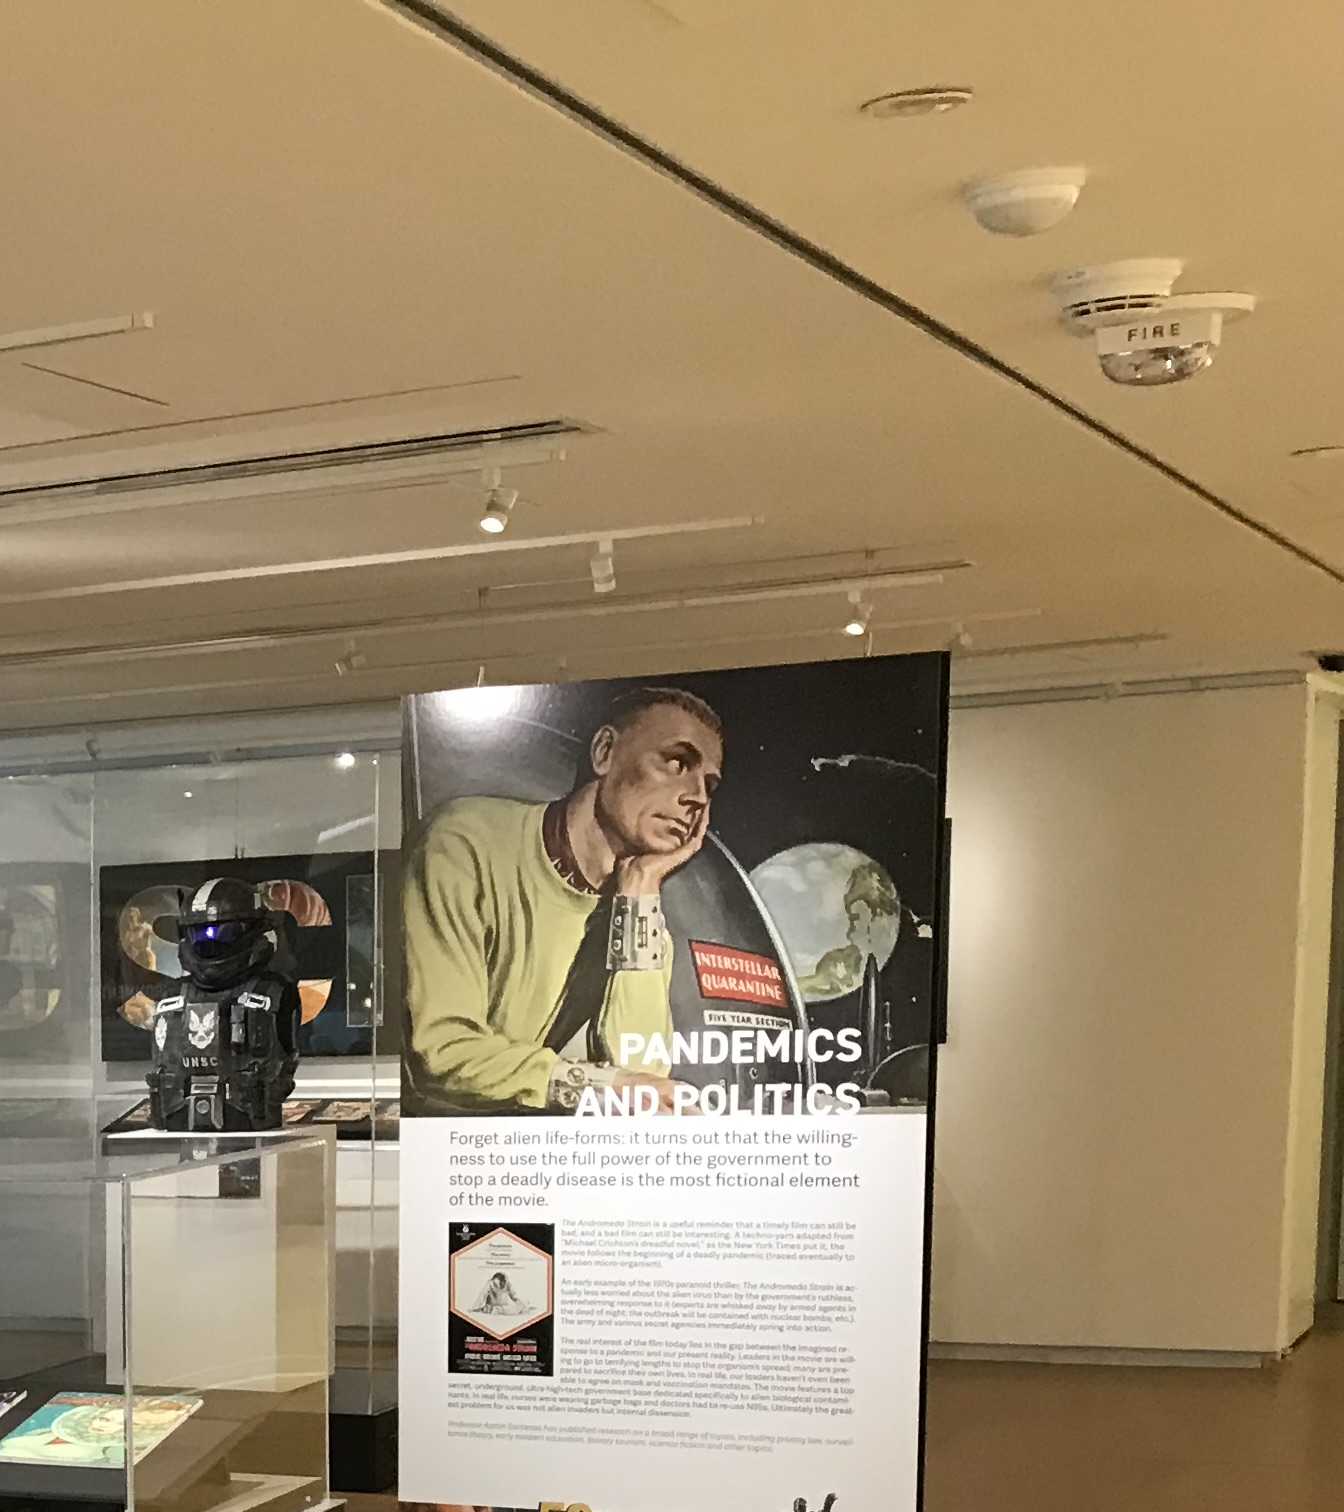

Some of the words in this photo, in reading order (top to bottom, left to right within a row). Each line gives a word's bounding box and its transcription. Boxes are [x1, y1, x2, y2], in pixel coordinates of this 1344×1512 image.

[1127, 322, 1181, 341] FIRE
[694, 951, 781, 981] INTERSTELLAR
[701, 973, 782, 1001] QUARANTINE
[708, 1013, 727, 1023] FIVE
[730, 1015, 753, 1026] YEAR
[619, 1028, 862, 1065] PANDEMICS
[182, 1056, 218, 1068] UNSC
[575, 1084, 661, 1117] AND
[673, 1083, 862, 1117] POLITICS
[449, 1131, 500, 1148] Forget
[503, 1130, 541, 1145] alien
[545, 1130, 625, 1145] life-forms:
[629, 1131, 640, 1145] it
[644, 1131, 688, 1145] turns
[692, 1131, 720, 1145] out
[724, 1130, 760, 1145] that
[763, 1129, 792, 1145] the
[796, 1129, 858, 1147] willing-
[449, 1154, 486, 1166] ness
[488, 1152, 506, 1166] to
[509, 1154, 537, 1166] use
[541, 1151, 568, 1166] the
[571, 1150, 596, 1166] full
[600, 1154, 651, 1169] power
[655, 1150, 672, 1166] of
[675, 1151, 703, 1166] the
[706, 1152, 810, 1170] government
[814, 1152, 832, 1166] to
[448, 1173, 484, 1189] stop
[487, 1175, 497, 1187] a
[500, 1171, 553, 1189] deadly
[555, 1171, 617, 1187] disease
[621, 1172, 634, 1187] is
[637, 1172, 665, 1187] the
[669, 1173, 712, 1187] most
[715, 1171, 785, 1188] fictional
[788, 1172, 861, 1188] element
[448, 1191, 466, 1207] of
[467, 1191, 495, 1207] the
[498, 1192, 549, 1207] movie.
